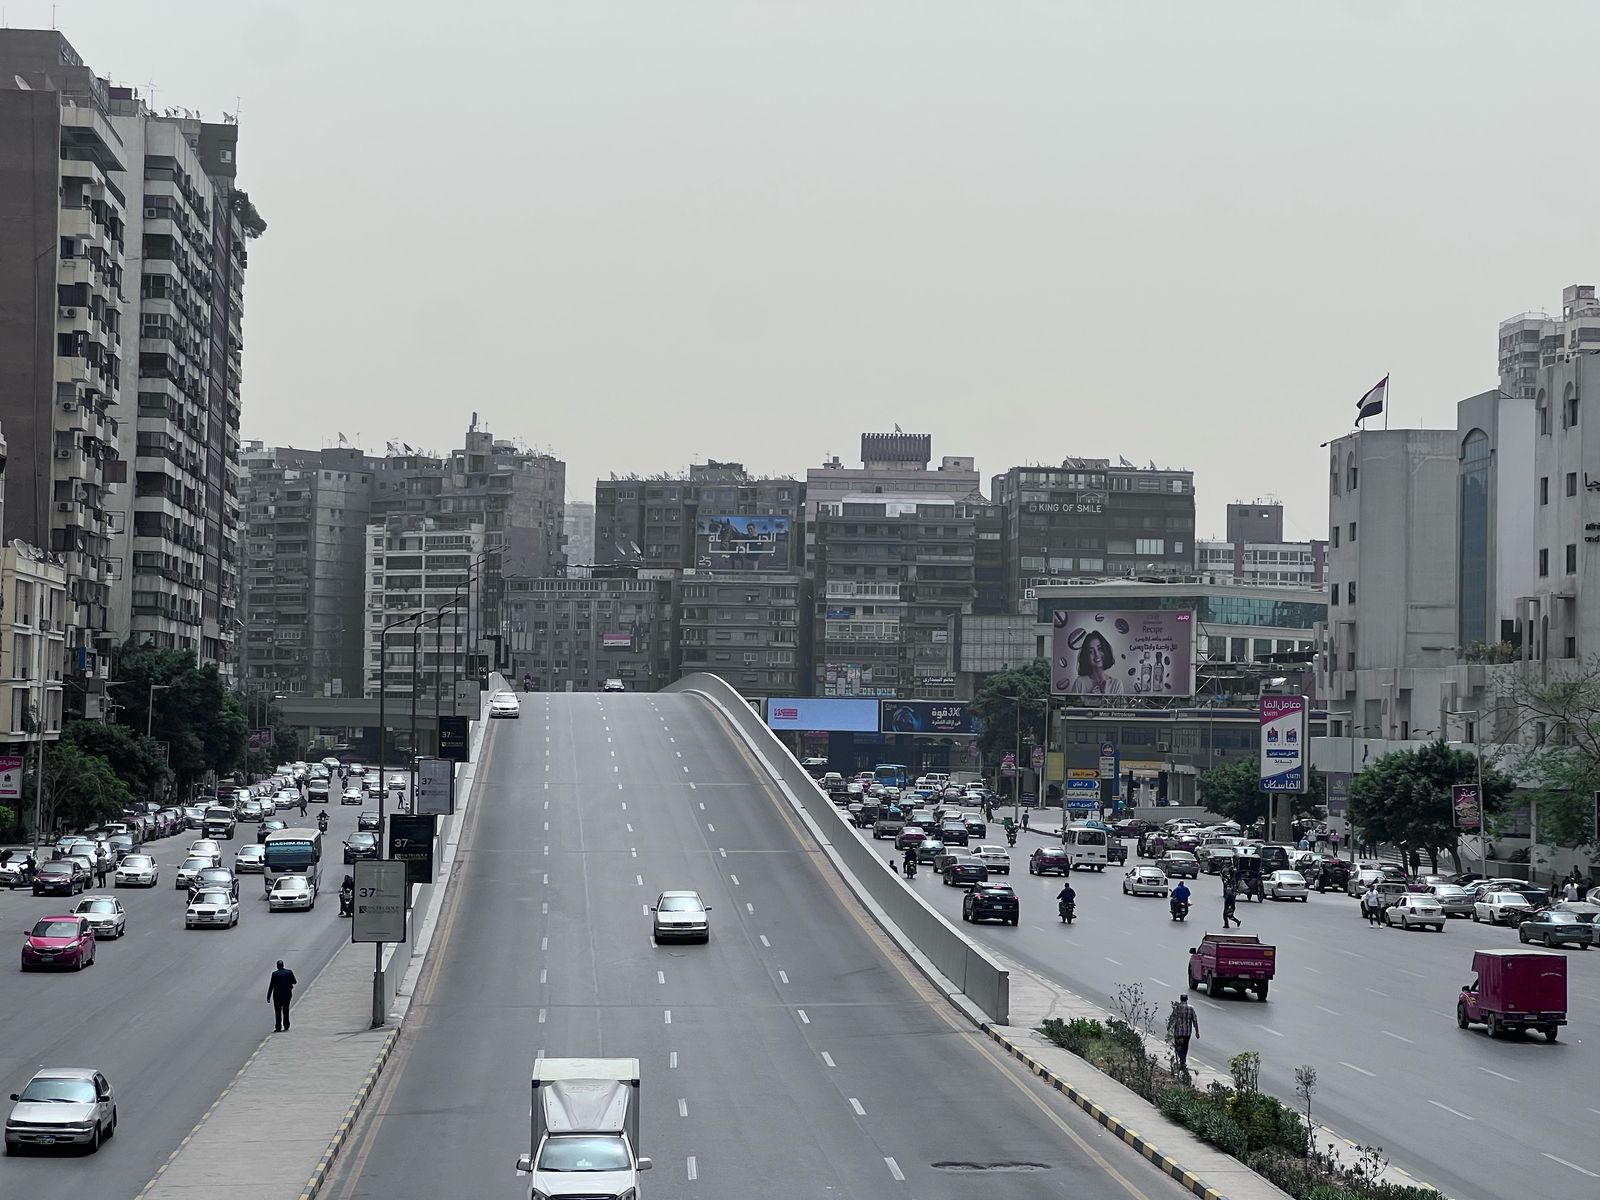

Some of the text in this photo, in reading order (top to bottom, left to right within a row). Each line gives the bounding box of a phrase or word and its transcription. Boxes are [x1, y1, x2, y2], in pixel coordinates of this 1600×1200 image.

[1038, 503, 1102, 513] KING OF SMILE
[1277, 700, 1301, 711] معامل
[931, 707, 947, 719] قوة
[421, 777, 432, 785] 37
[394, 838, 409, 848] 37
[359, 888, 376, 898] 37
